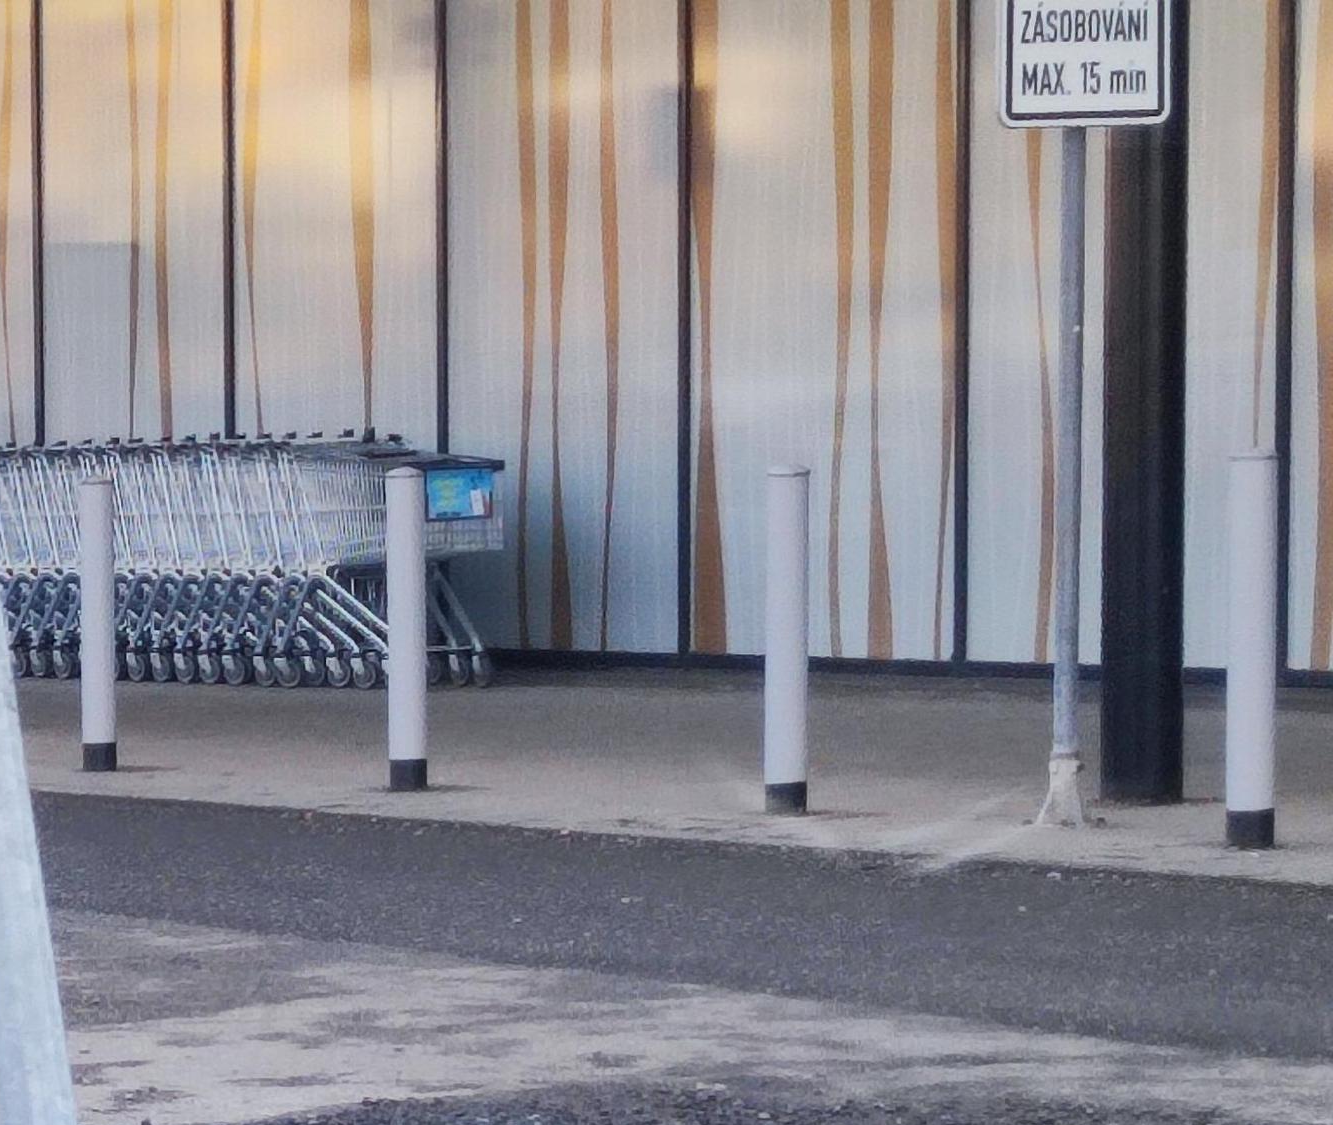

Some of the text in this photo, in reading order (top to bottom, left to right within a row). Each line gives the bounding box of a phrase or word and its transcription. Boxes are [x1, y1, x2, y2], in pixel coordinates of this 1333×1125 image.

[1020, 1, 1149, 43] ZÁSOBOVÁNÍ
[1021, 60, 1147, 95] MAX. 15 min
